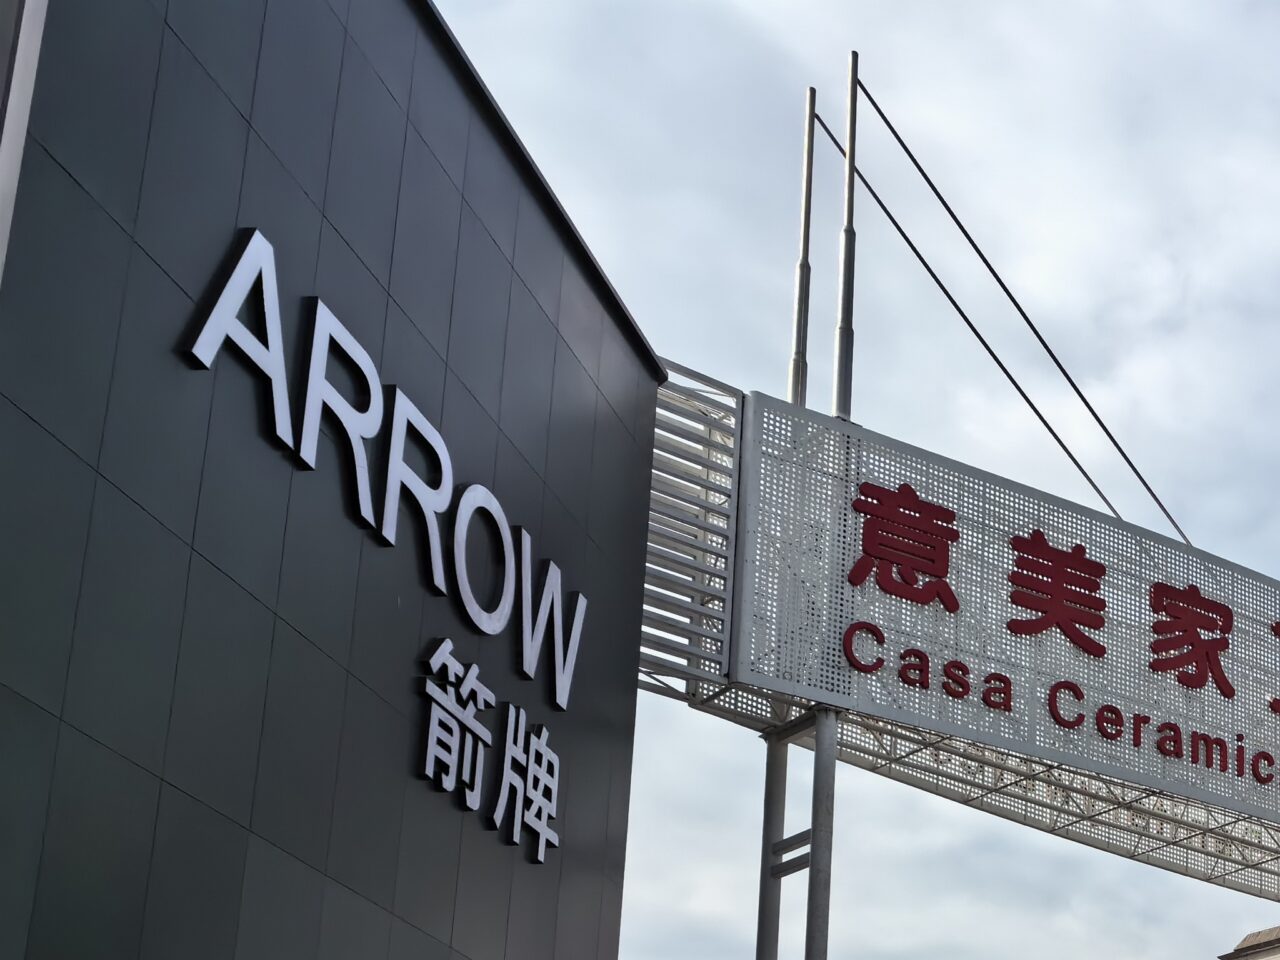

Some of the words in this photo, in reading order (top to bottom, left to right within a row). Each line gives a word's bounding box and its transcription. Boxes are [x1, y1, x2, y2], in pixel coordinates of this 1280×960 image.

[186, 227, 588, 711] ARROW
[424, 637, 560, 864] 箭牌
[843, 621, 1012, 713] Casa
